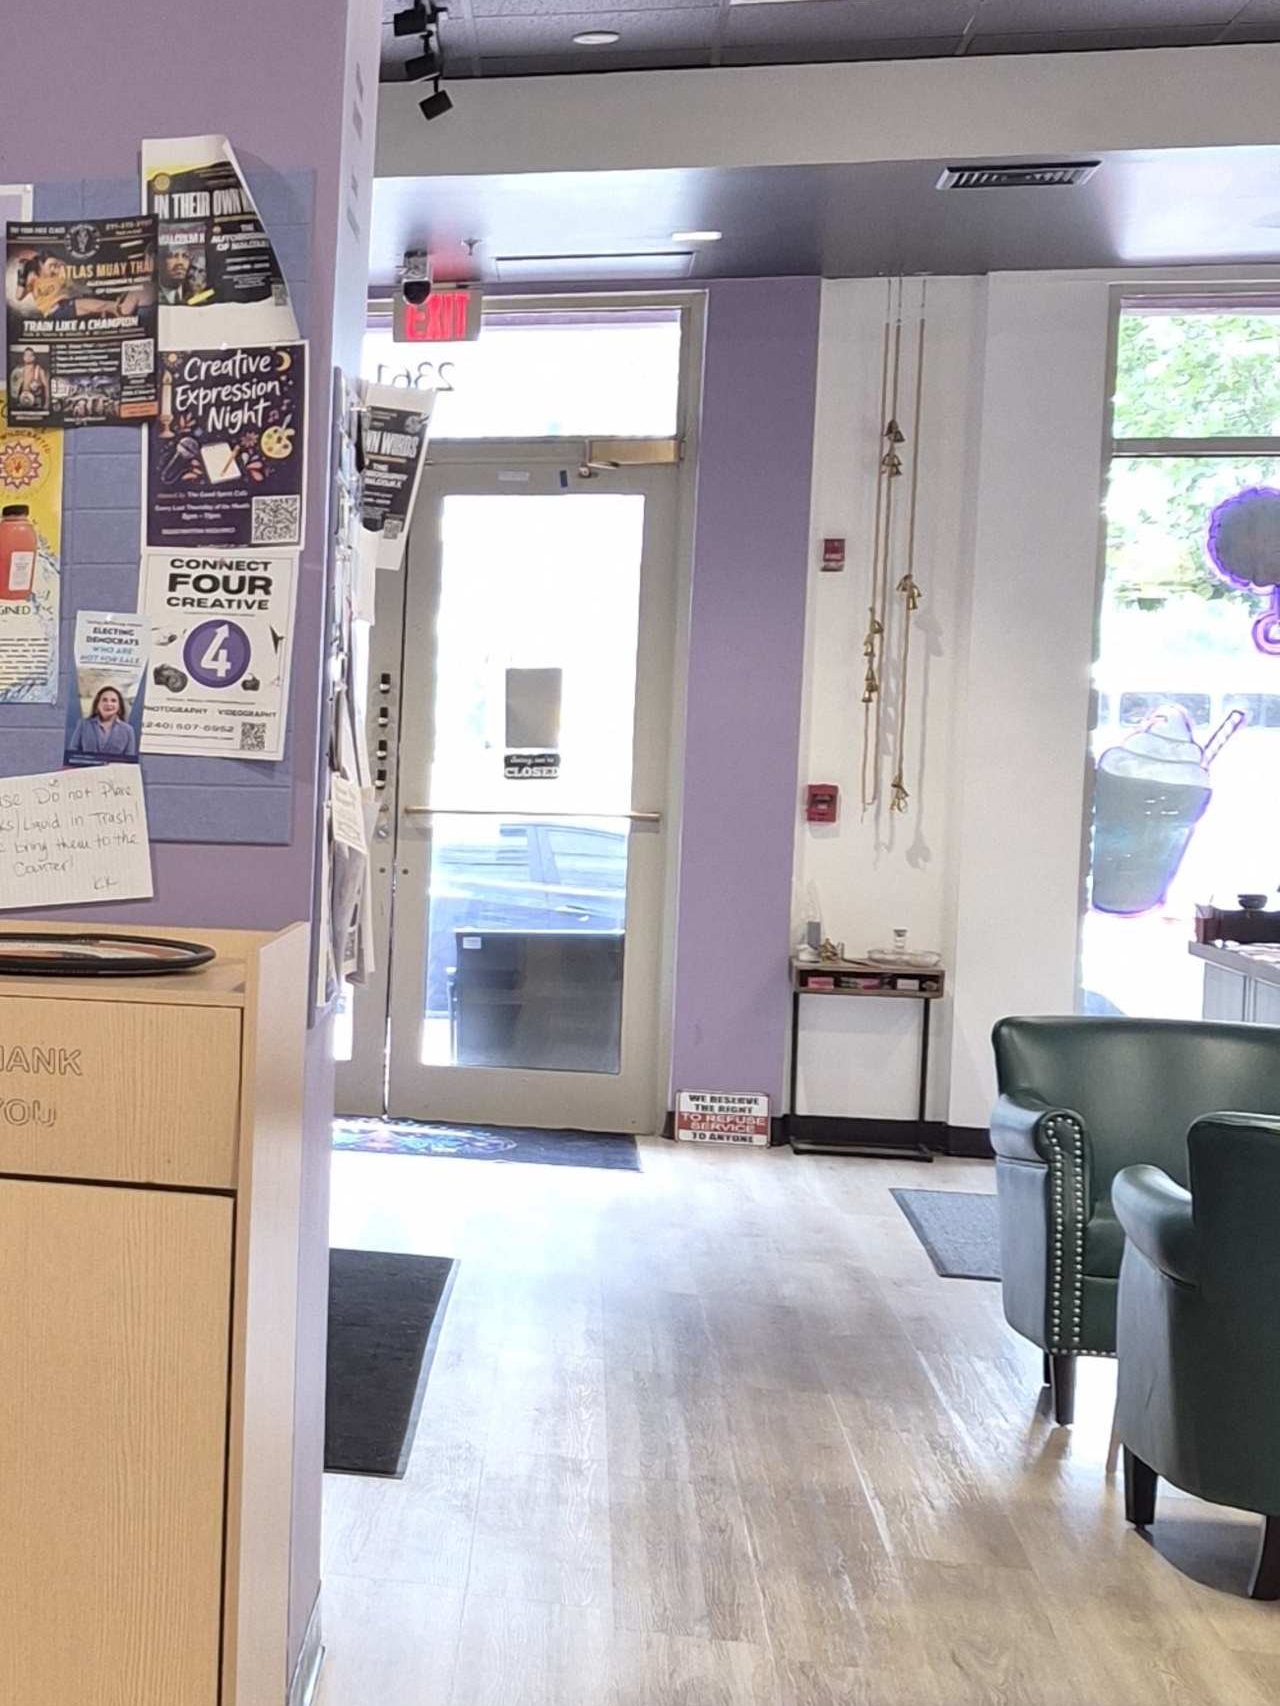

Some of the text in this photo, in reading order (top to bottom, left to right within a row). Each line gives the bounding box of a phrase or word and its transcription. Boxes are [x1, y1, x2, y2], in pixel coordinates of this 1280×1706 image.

[172, 191, 210, 218] THEIR
[60, 263, 93, 279] ATLAS
[96, 261, 126, 278] MUAY
[405, 291, 470, 341] EXIT
[183, 349, 271, 382] Creative
[175, 378, 280, 416] Expression
[208, 399, 271, 434] Night
[170, 558, 272, 572] CONNECT
[168, 573, 273, 596] FOUR
[166, 596, 269, 611] CREATIVE
[86, 635, 139, 646] DEMOCRATS
[218, 709, 277, 718] VIDEOGRAPHY
[504, 766, 559, 777] CLOSED
[33, 786, 61, 805] Do
[690, 1121, 755, 1133] SERVICE
[706, 1114, 766, 1125] REFUSE
